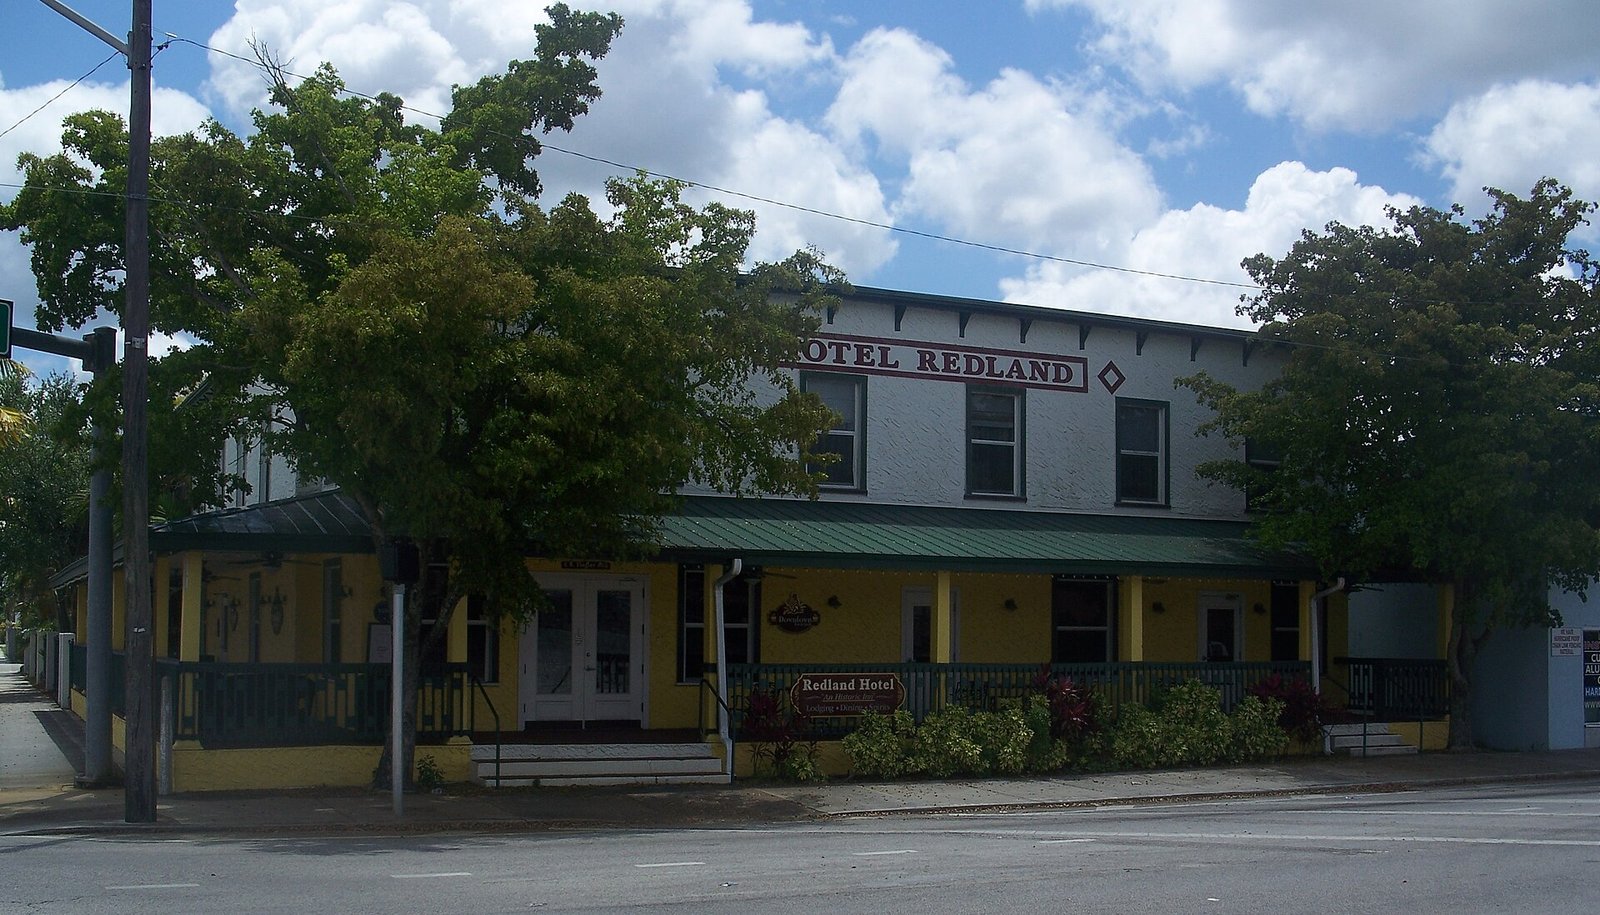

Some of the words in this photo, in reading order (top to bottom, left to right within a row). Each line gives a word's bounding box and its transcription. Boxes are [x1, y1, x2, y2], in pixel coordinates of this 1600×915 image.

[801, 340, 899, 369] OTEL
[916, 350, 1074, 384] REDLAND
[802, 678, 856, 691] Redland
[859, 678, 895, 690] Hotel
[835, 693, 860, 701] Historic
[806, 705, 834, 713] Lodging
[840, 704, 863, 712] Dining
